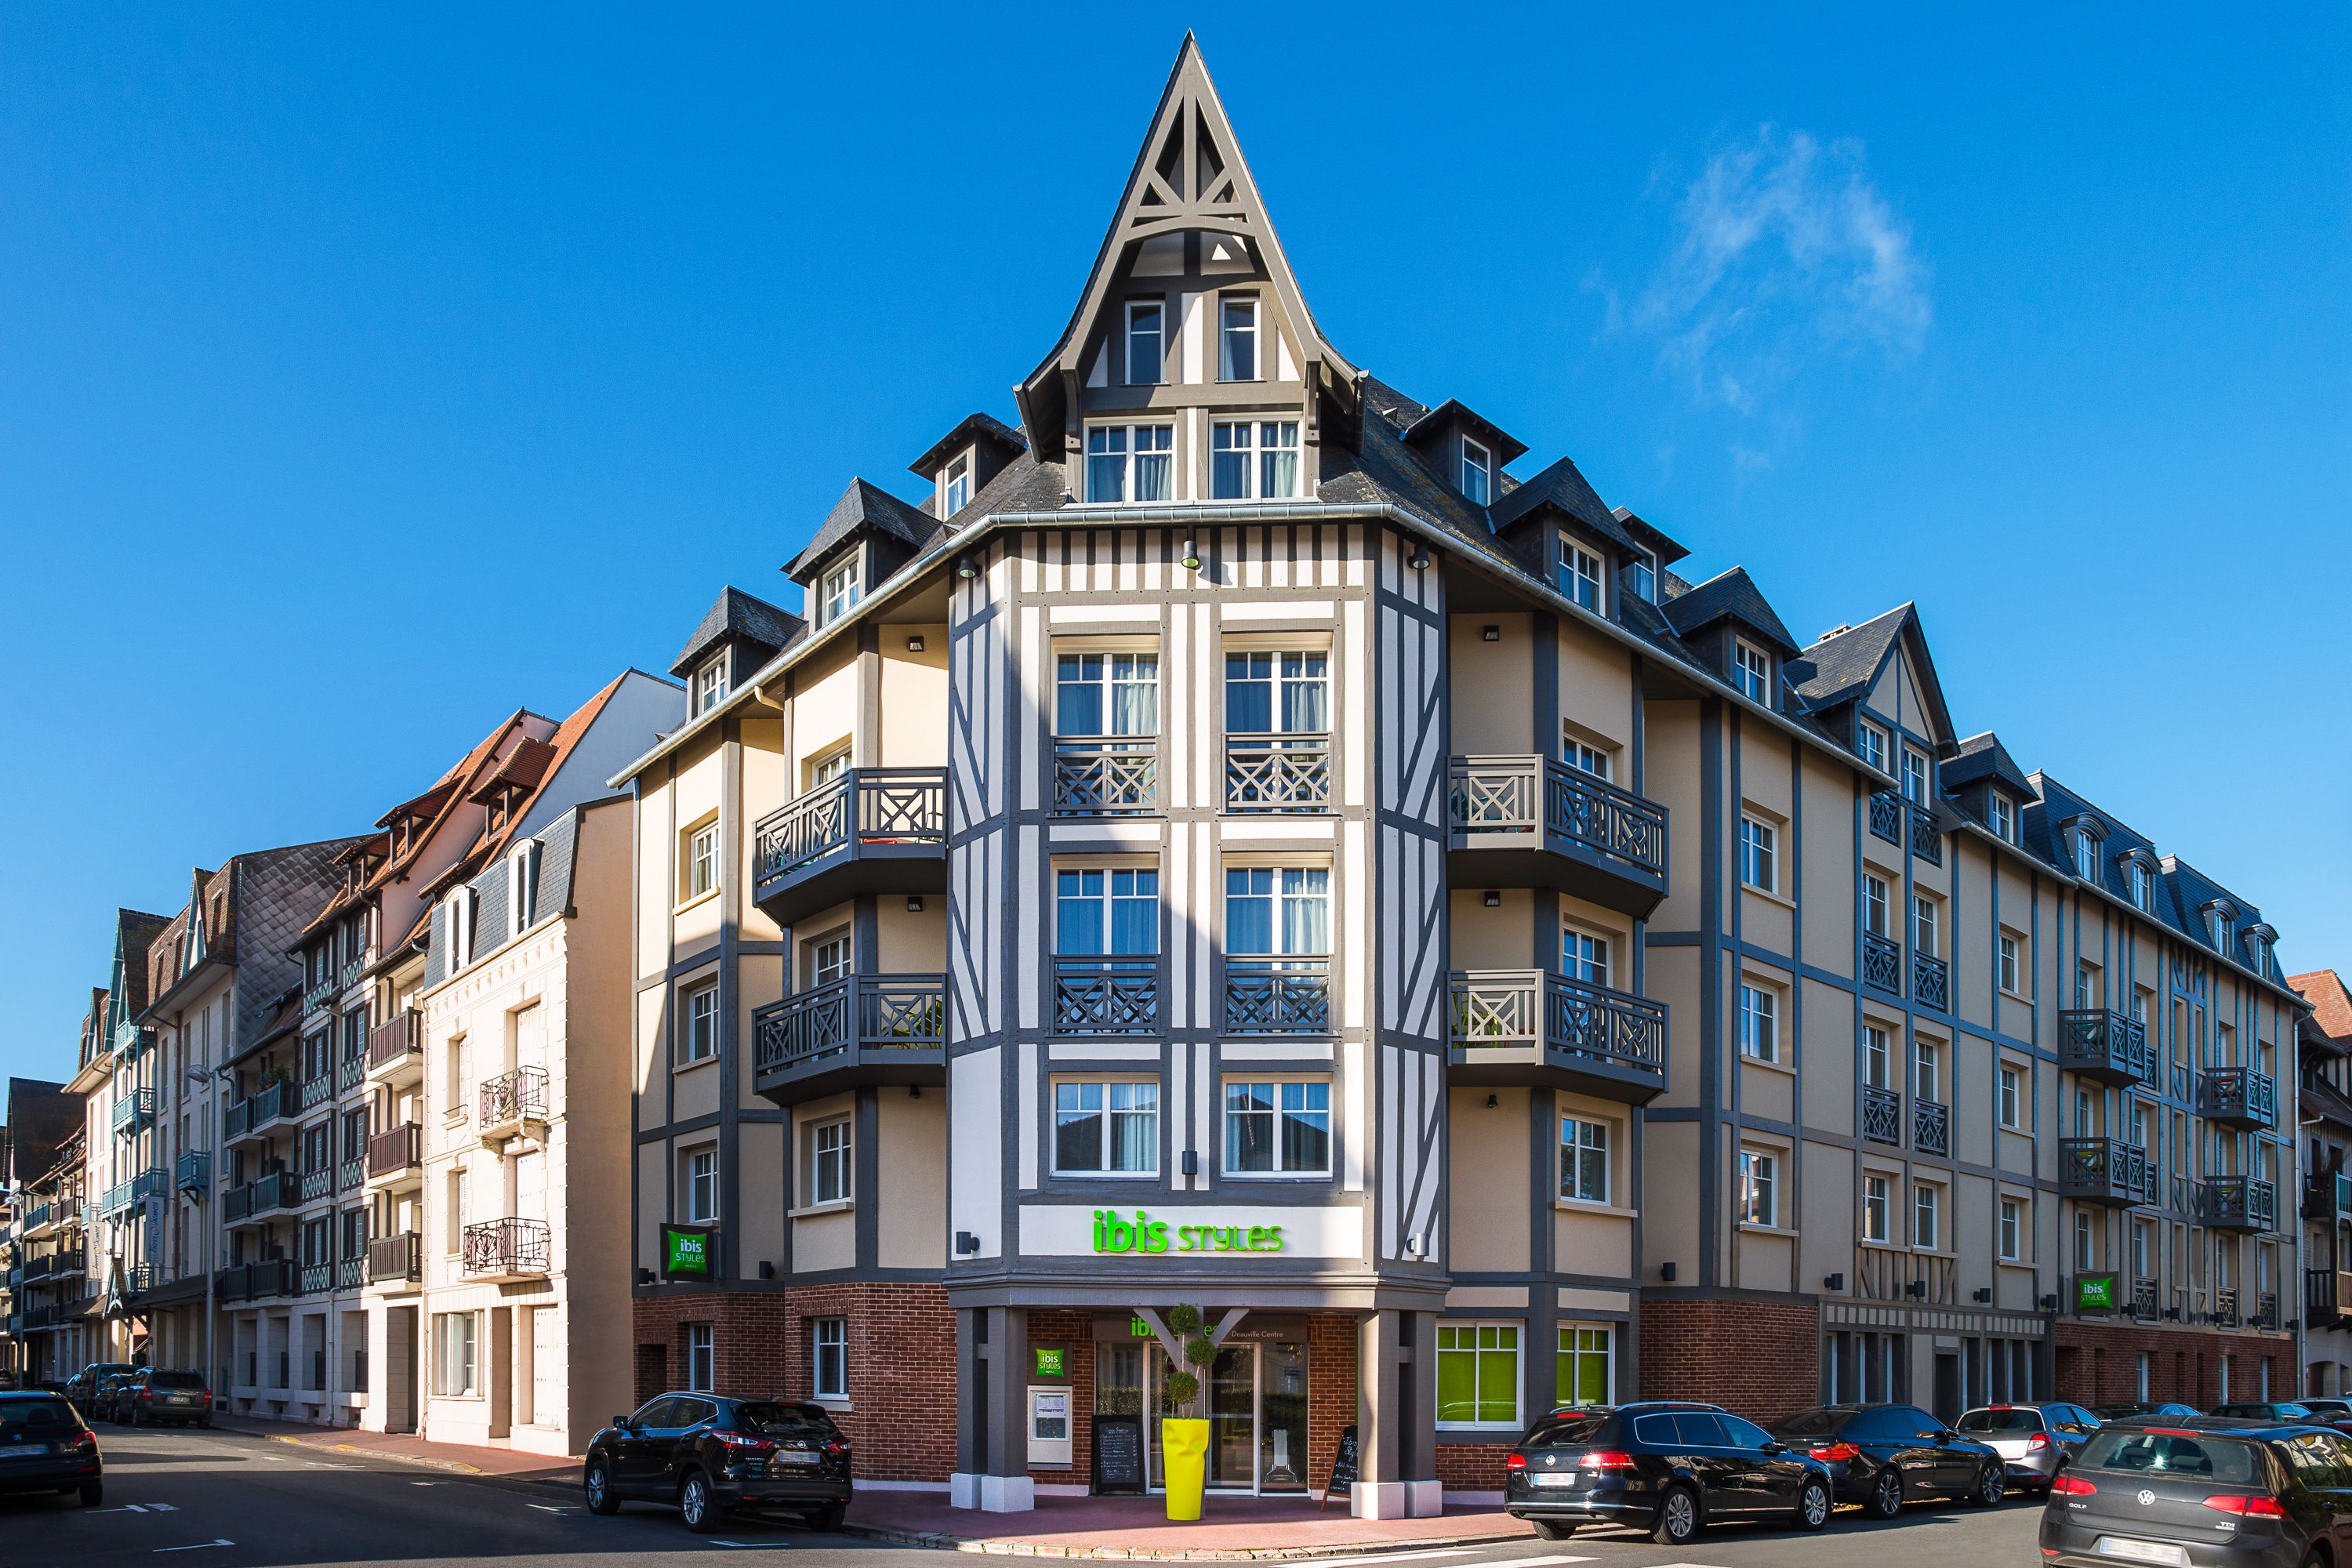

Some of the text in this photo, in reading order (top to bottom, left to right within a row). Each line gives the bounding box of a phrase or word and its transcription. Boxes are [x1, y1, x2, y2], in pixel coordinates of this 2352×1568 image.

[1093, 1210, 1168, 1253] ibis
[680, 1239, 702, 1253] ibis
[2084, 1283, 2103, 1294] ibis
[1131, 1317, 1155, 1337] ib
[1042, 1353, 1058, 1363] ibis
